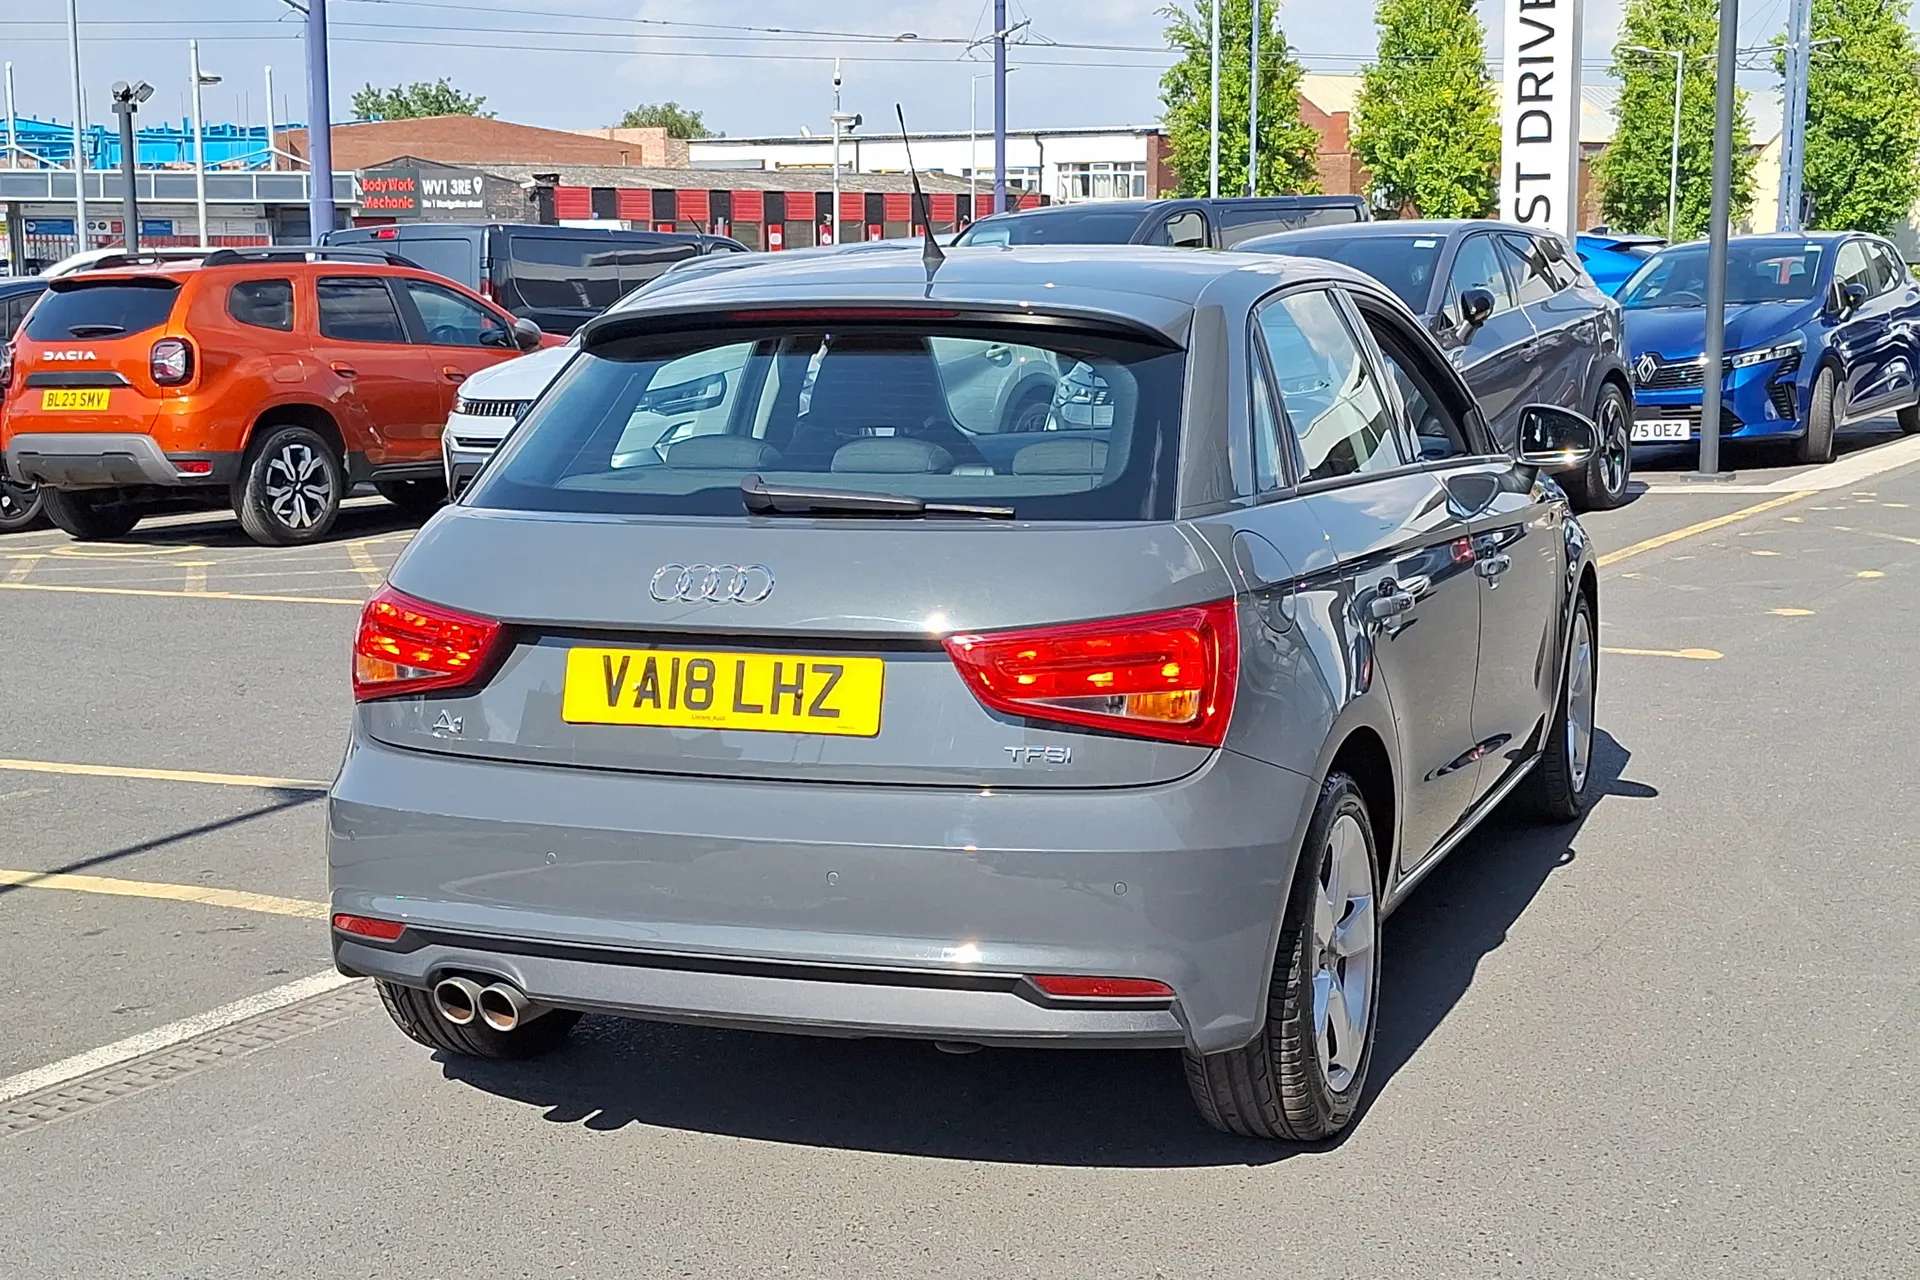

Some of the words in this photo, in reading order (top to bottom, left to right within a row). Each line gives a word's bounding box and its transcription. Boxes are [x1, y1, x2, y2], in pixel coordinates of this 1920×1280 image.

[422, 179, 448, 195] WV1
[450, 179, 472, 195] 3RE
[362, 195, 415, 209] Mechanic
[43, 350, 97, 361] DACIA
[47, 392, 77, 408] BL23
[80, 392, 104, 408] SMV
[603, 655, 716, 711] VA18
[732, 659, 844, 718] LHZ
[1003, 746, 1072, 764] TFSI
